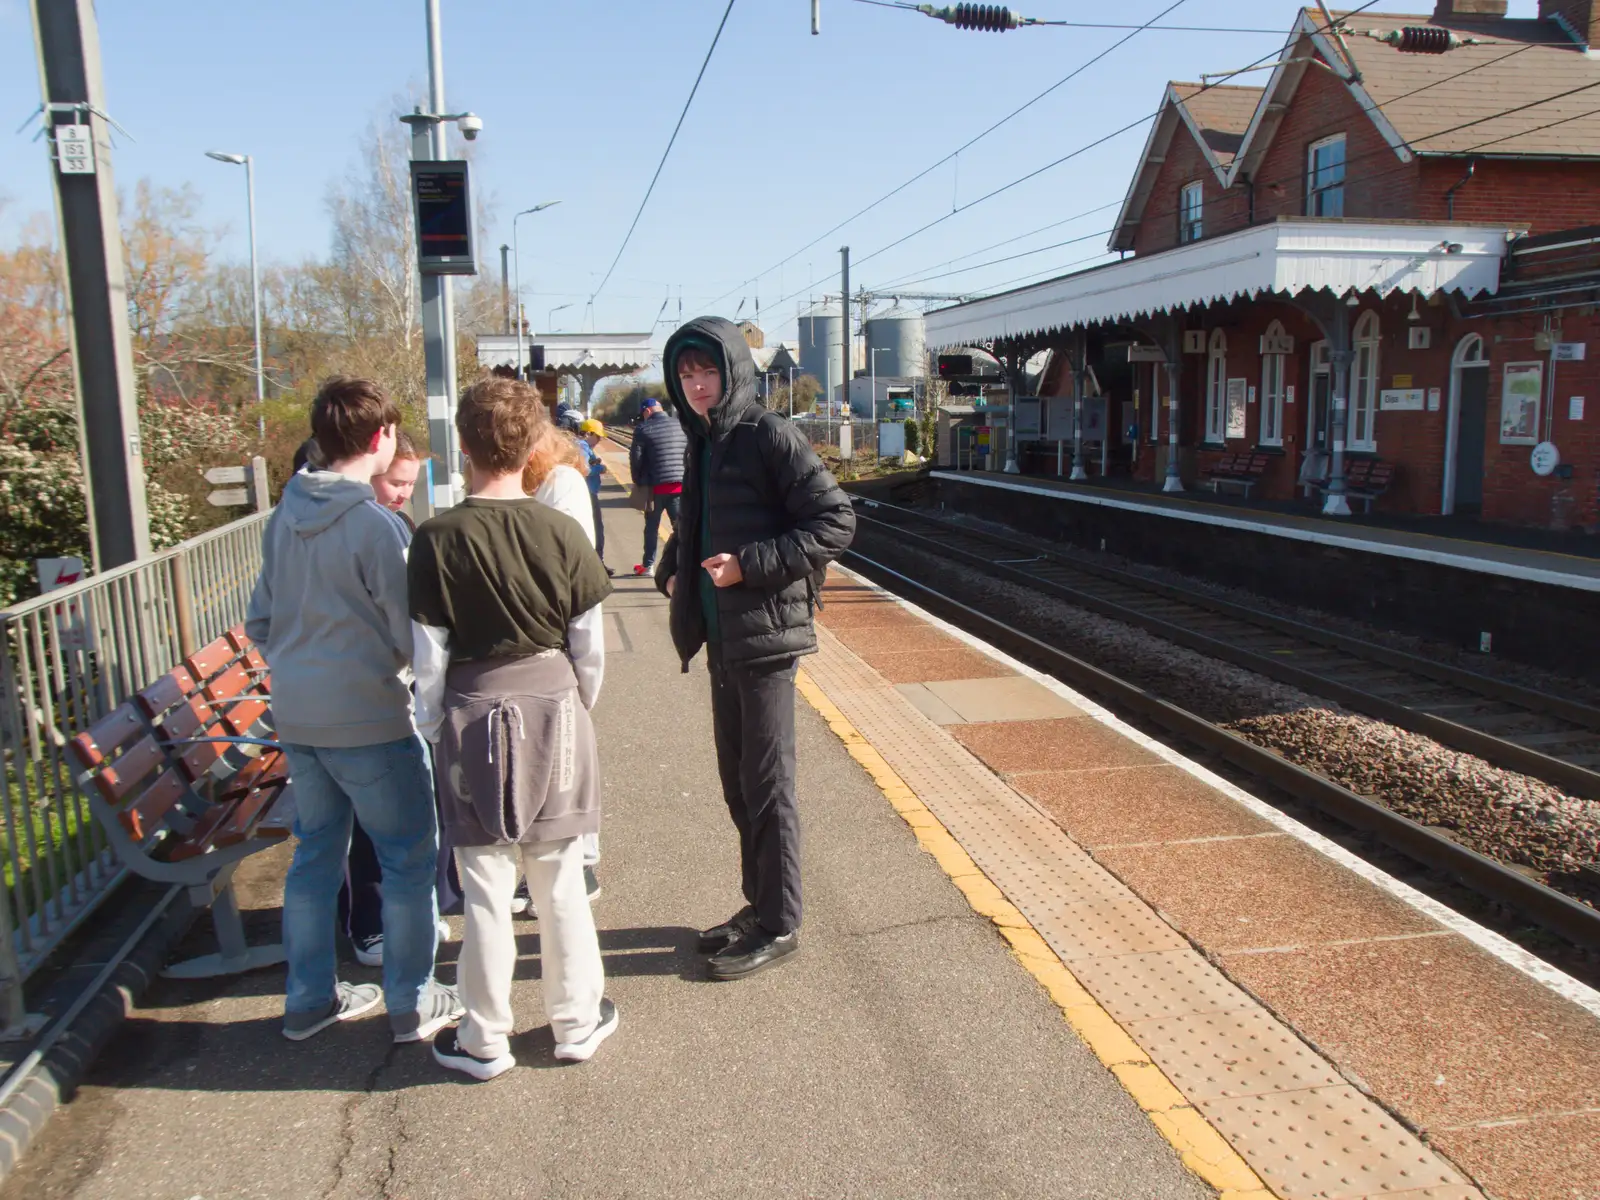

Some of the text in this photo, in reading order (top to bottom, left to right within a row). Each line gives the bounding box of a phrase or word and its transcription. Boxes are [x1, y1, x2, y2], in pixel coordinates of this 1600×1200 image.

[65, 144, 84, 155] 152
[68, 159, 85, 170] 33
[1192, 334, 1198, 350] 1
